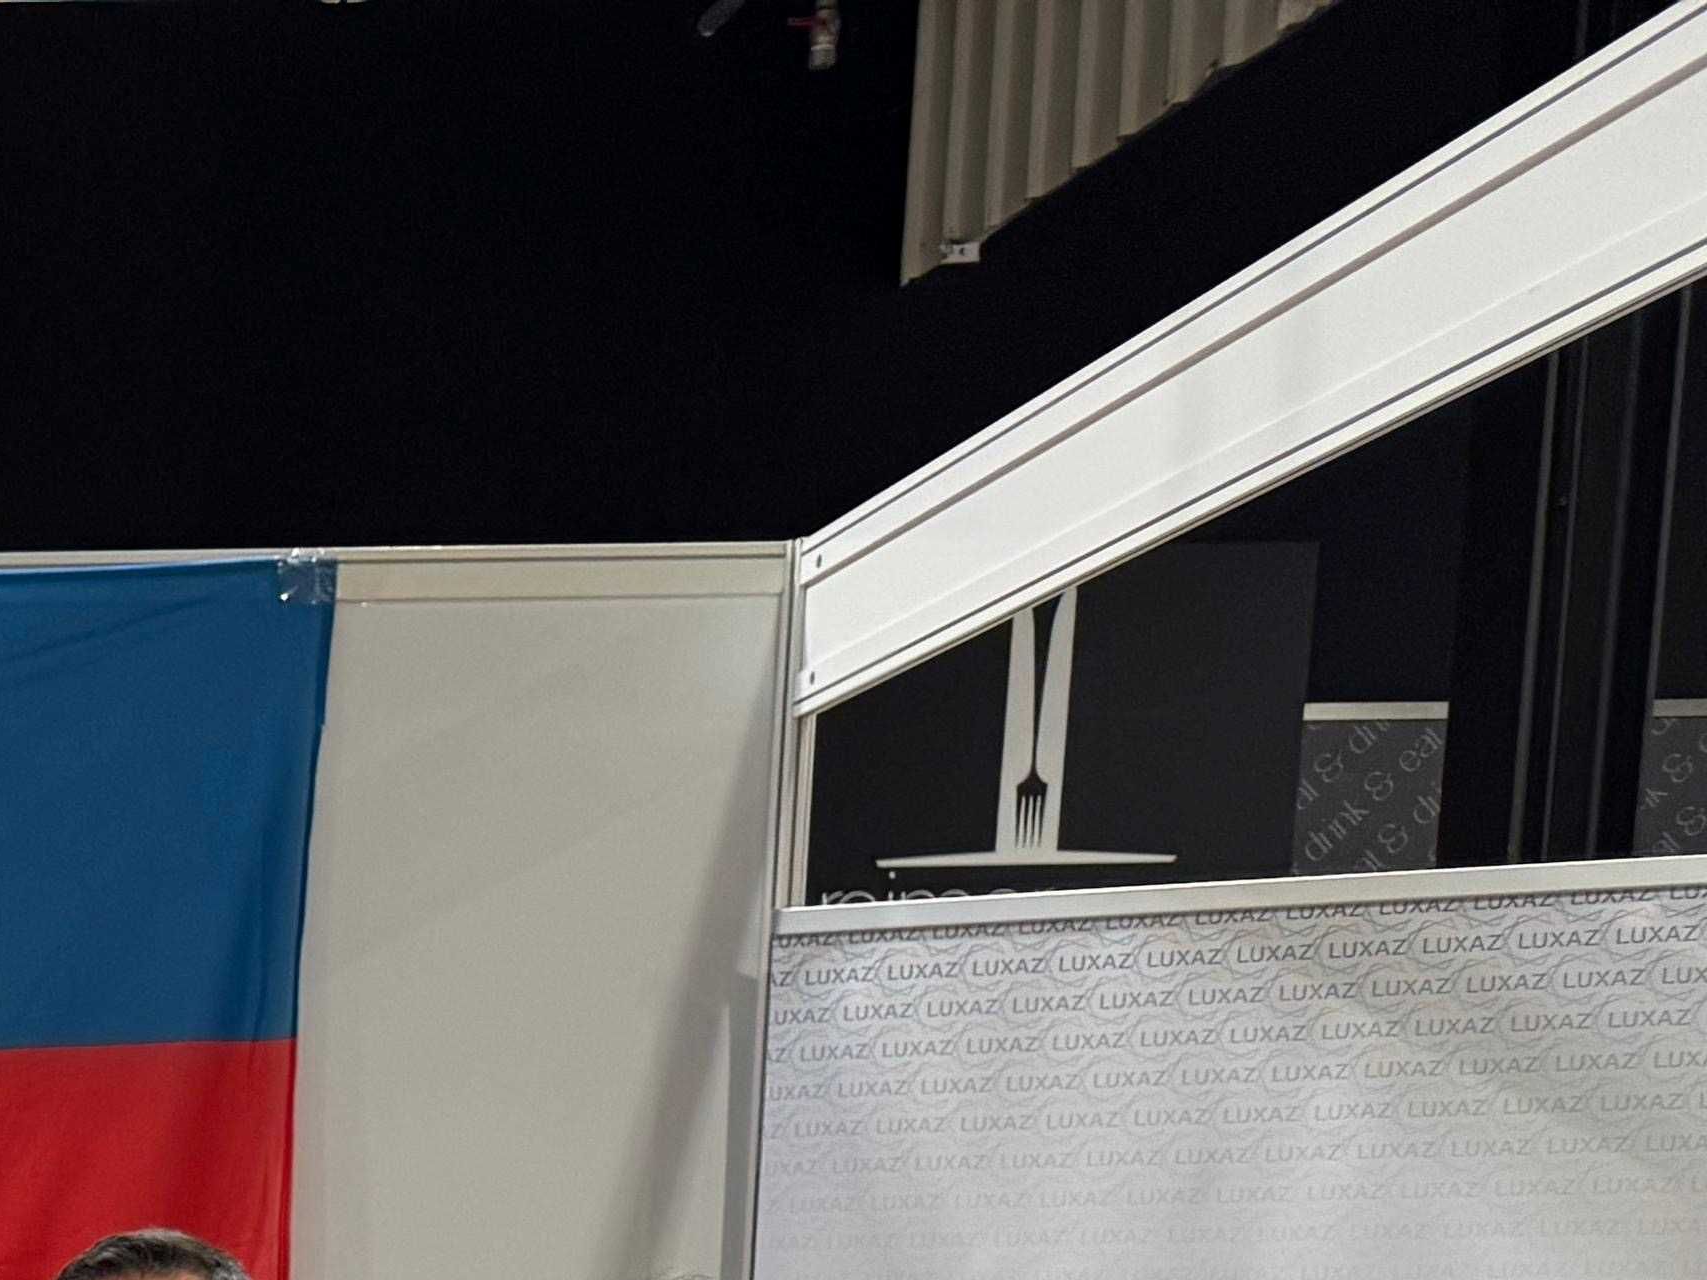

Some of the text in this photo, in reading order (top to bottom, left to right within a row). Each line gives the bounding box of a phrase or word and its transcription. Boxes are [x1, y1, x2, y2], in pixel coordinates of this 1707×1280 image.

[805, 966, 874, 985] LUXAZ
[889, 962, 958, 981] LUXAZ
[973, 957, 1044, 977] LUXAZ
[1059, 953, 1133, 973] LUXAZ
[1147, 948, 1222, 967] LUXAZ
[1237, 943, 1314, 963] LUXAZ
[1329, 939, 1406, 958] LUXAZ
[1423, 934, 1502, 954] LUXAZ
[1518, 929, 1598, 949] LUXAZ
[1616, 925, 1698, 945] LUXAZ
[775, 968, 1645, 1025] UXAZ LUXAZ LUXAZ LUXAZ LUXAZ LUXAZ LUXAZ LUXAZ LUXAZ LUXAZ
[800, 1044, 868, 1062] LUXAZ
[882, 1040, 953, 1058] LUXAZ
[966, 1035, 1038, 1054] LUXAZ
[1053, 1032, 1126, 1051] LUXAZ
[1141, 1027, 1216, 1046] LUXAZ
[1230, 1024, 1306, 1043] LUXAZ
[1322, 1020, 1399, 1040] LUXAZ
[1415, 1016, 1494, 1036] LUXAZ
[1511, 1012, 1592, 1032] LUXAZ
[1608, 1009, 1691, 1029] LUXAZ
[838, 1055, 1538, 1098] LUXAZ LUXAZ LUXAZ LUXAZ
